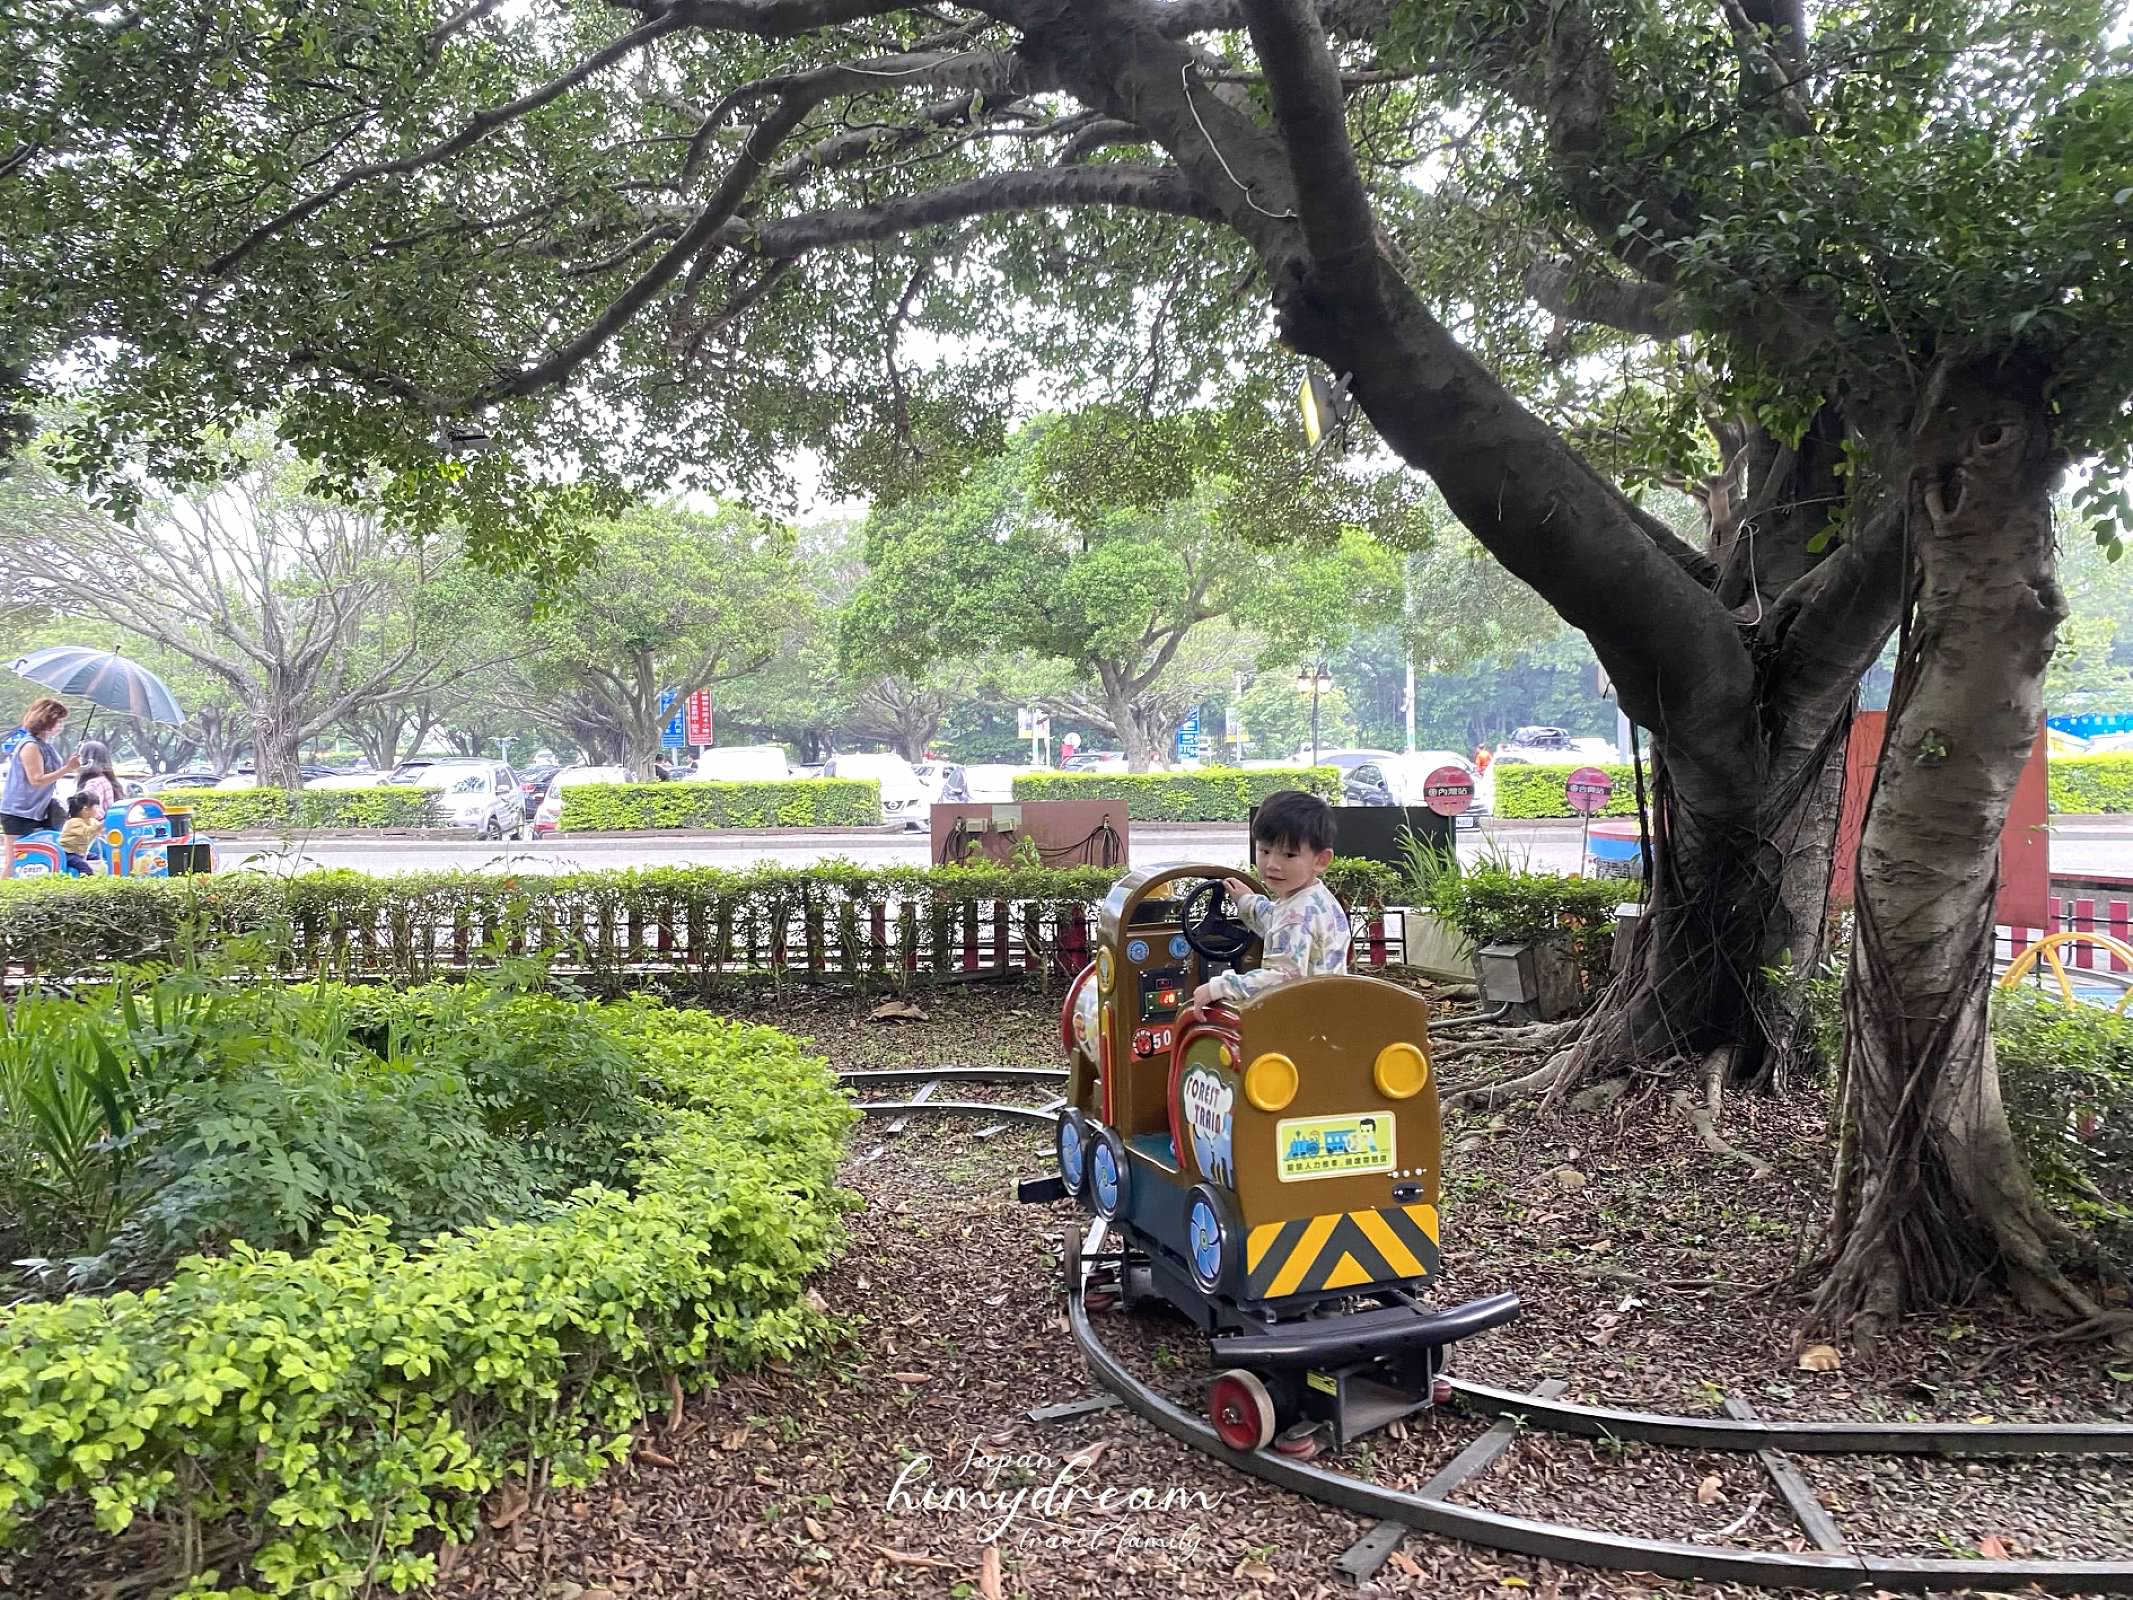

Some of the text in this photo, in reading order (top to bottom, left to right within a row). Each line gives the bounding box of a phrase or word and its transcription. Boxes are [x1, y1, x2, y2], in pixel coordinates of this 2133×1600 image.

[1153, 1029, 1172, 1049] 50
[1185, 1076, 1221, 1106] FOREST
[1194, 1104, 1221, 1134] TRAIN
